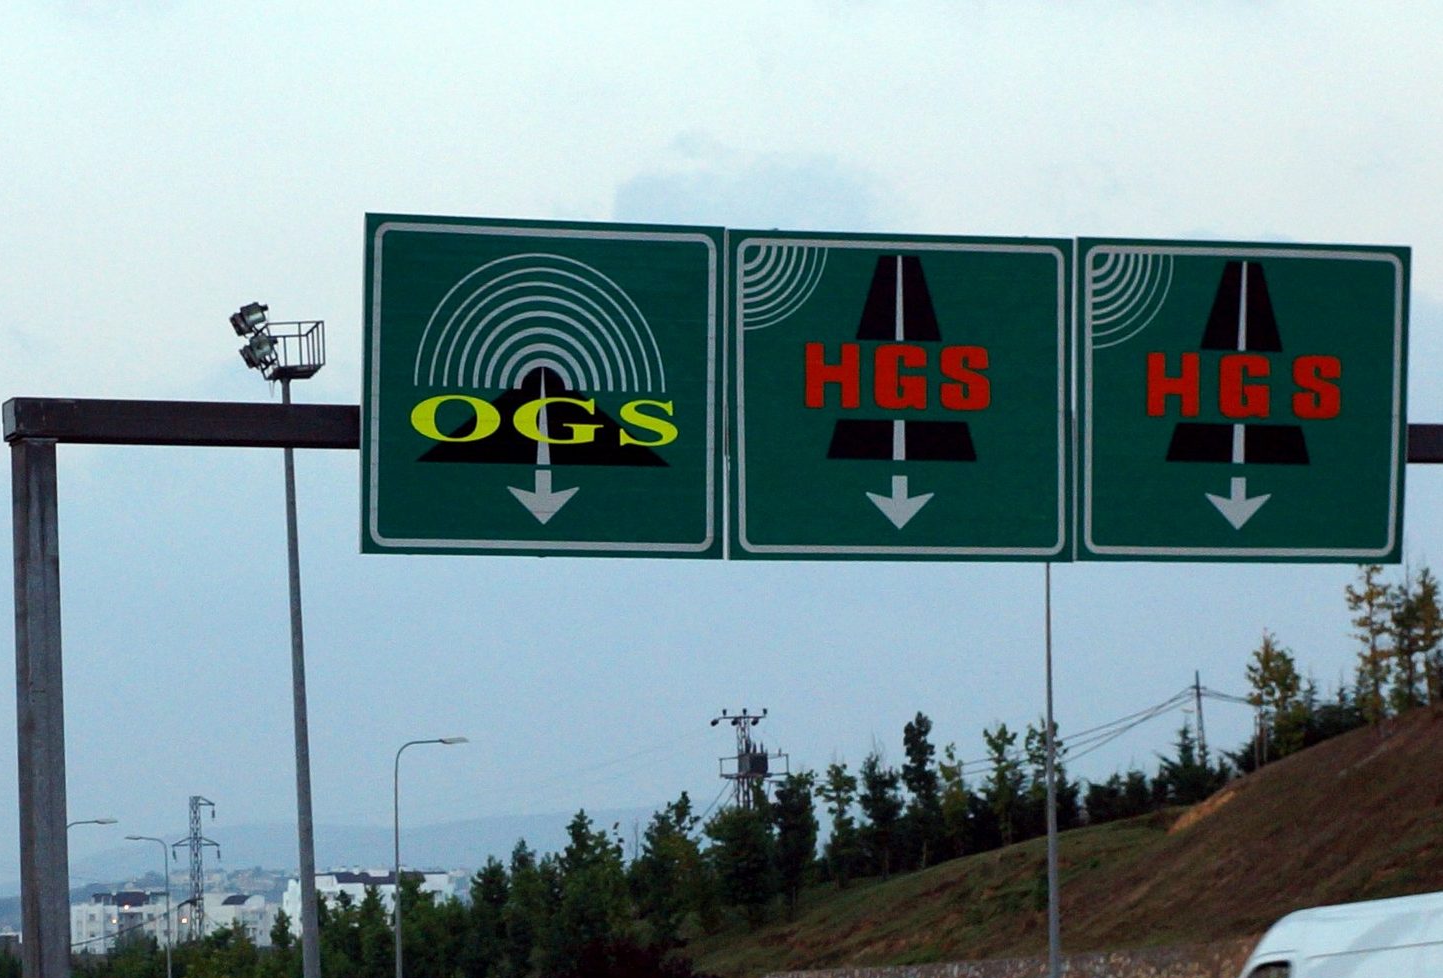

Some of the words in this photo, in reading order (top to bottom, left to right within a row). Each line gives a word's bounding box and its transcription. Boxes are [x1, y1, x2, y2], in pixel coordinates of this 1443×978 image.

[804, 342, 992, 411] HGS
[1147, 351, 1343, 419] HGS
[410, 395, 679, 446] OGS
